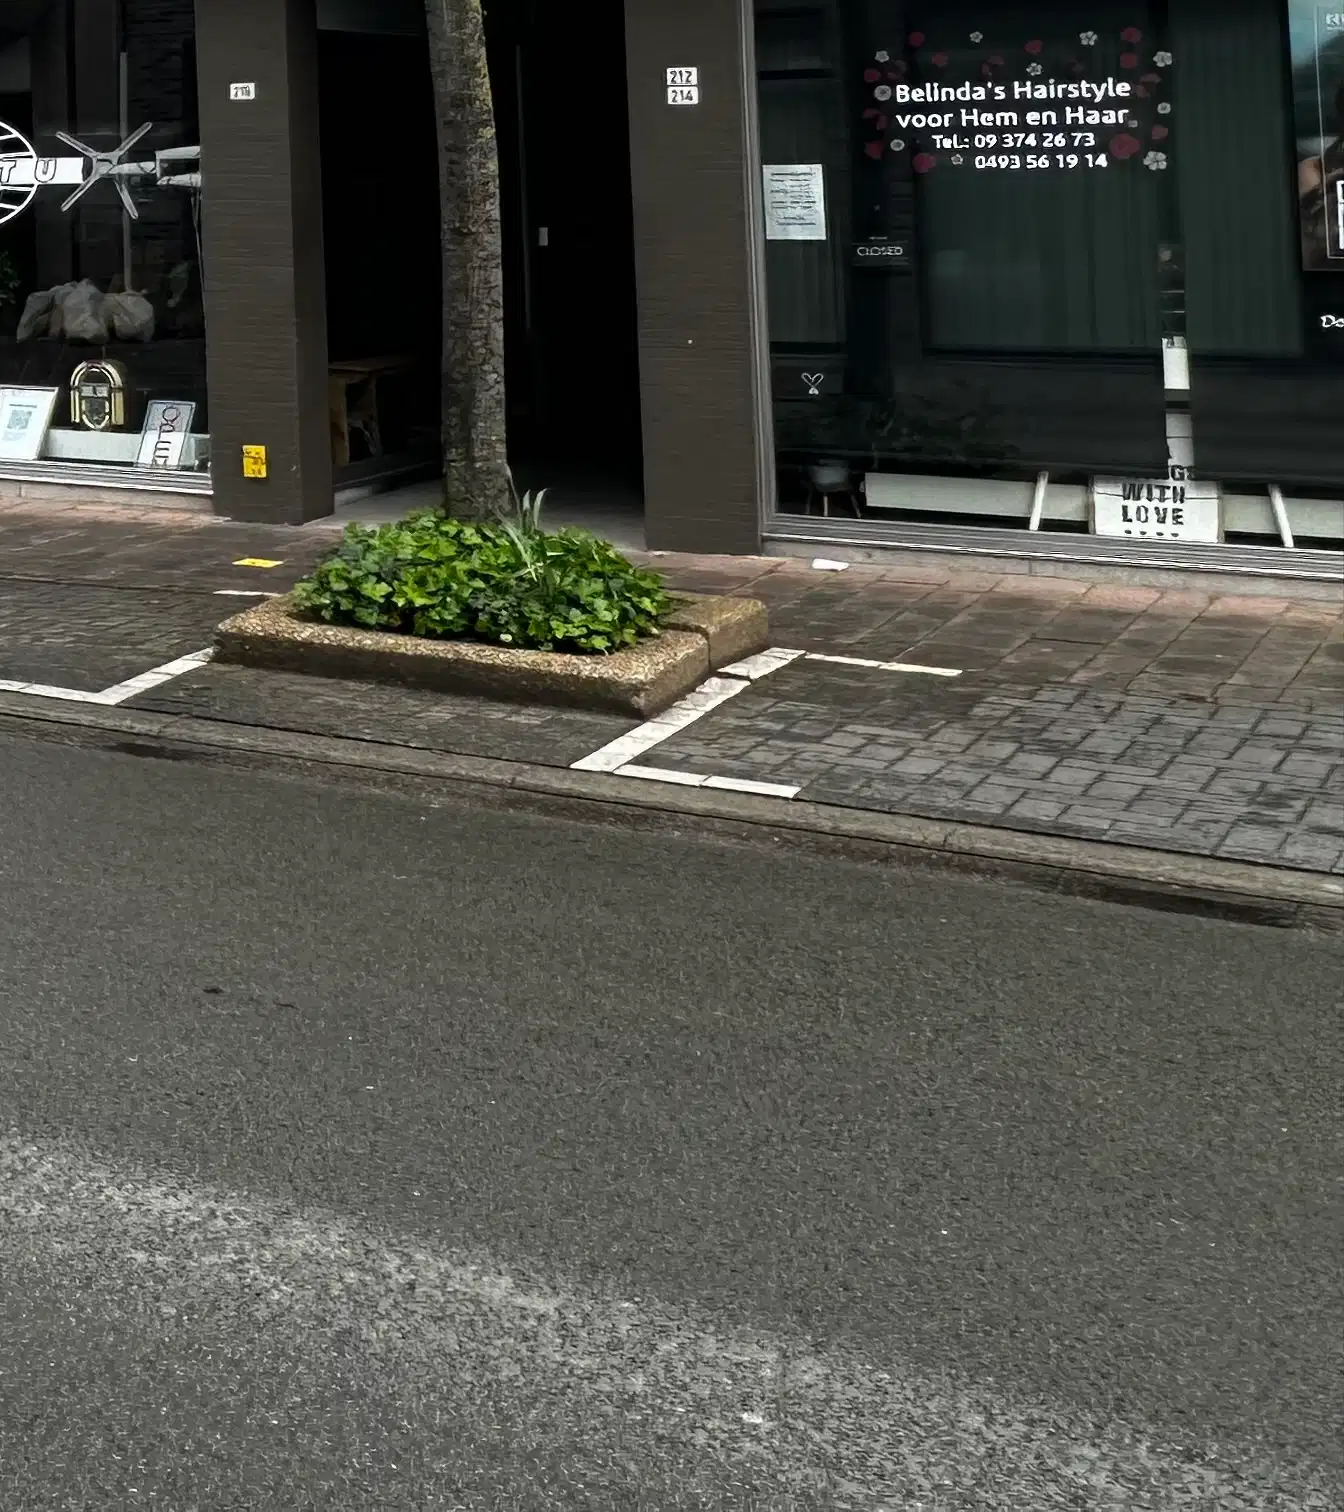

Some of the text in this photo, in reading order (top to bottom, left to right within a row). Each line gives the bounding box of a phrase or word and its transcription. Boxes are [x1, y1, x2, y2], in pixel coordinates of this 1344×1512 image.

[670, 70, 692, 84] 212
[672, 89, 693, 103] 214
[895, 77, 1132, 103] Belinda's Hairstyle
[895, 105, 1129, 128] voor Hem en Haar
[974, 134, 998, 149] 09
[1002, 133, 1037, 148] 374
[1042, 133, 1065, 147] 26
[1071, 132, 1095, 147] 73
[974, 153, 1108, 170] 0493 56 19 14
[1122, 483, 1185, 504] WITH
[1122, 505, 1184, 525] LOVE
